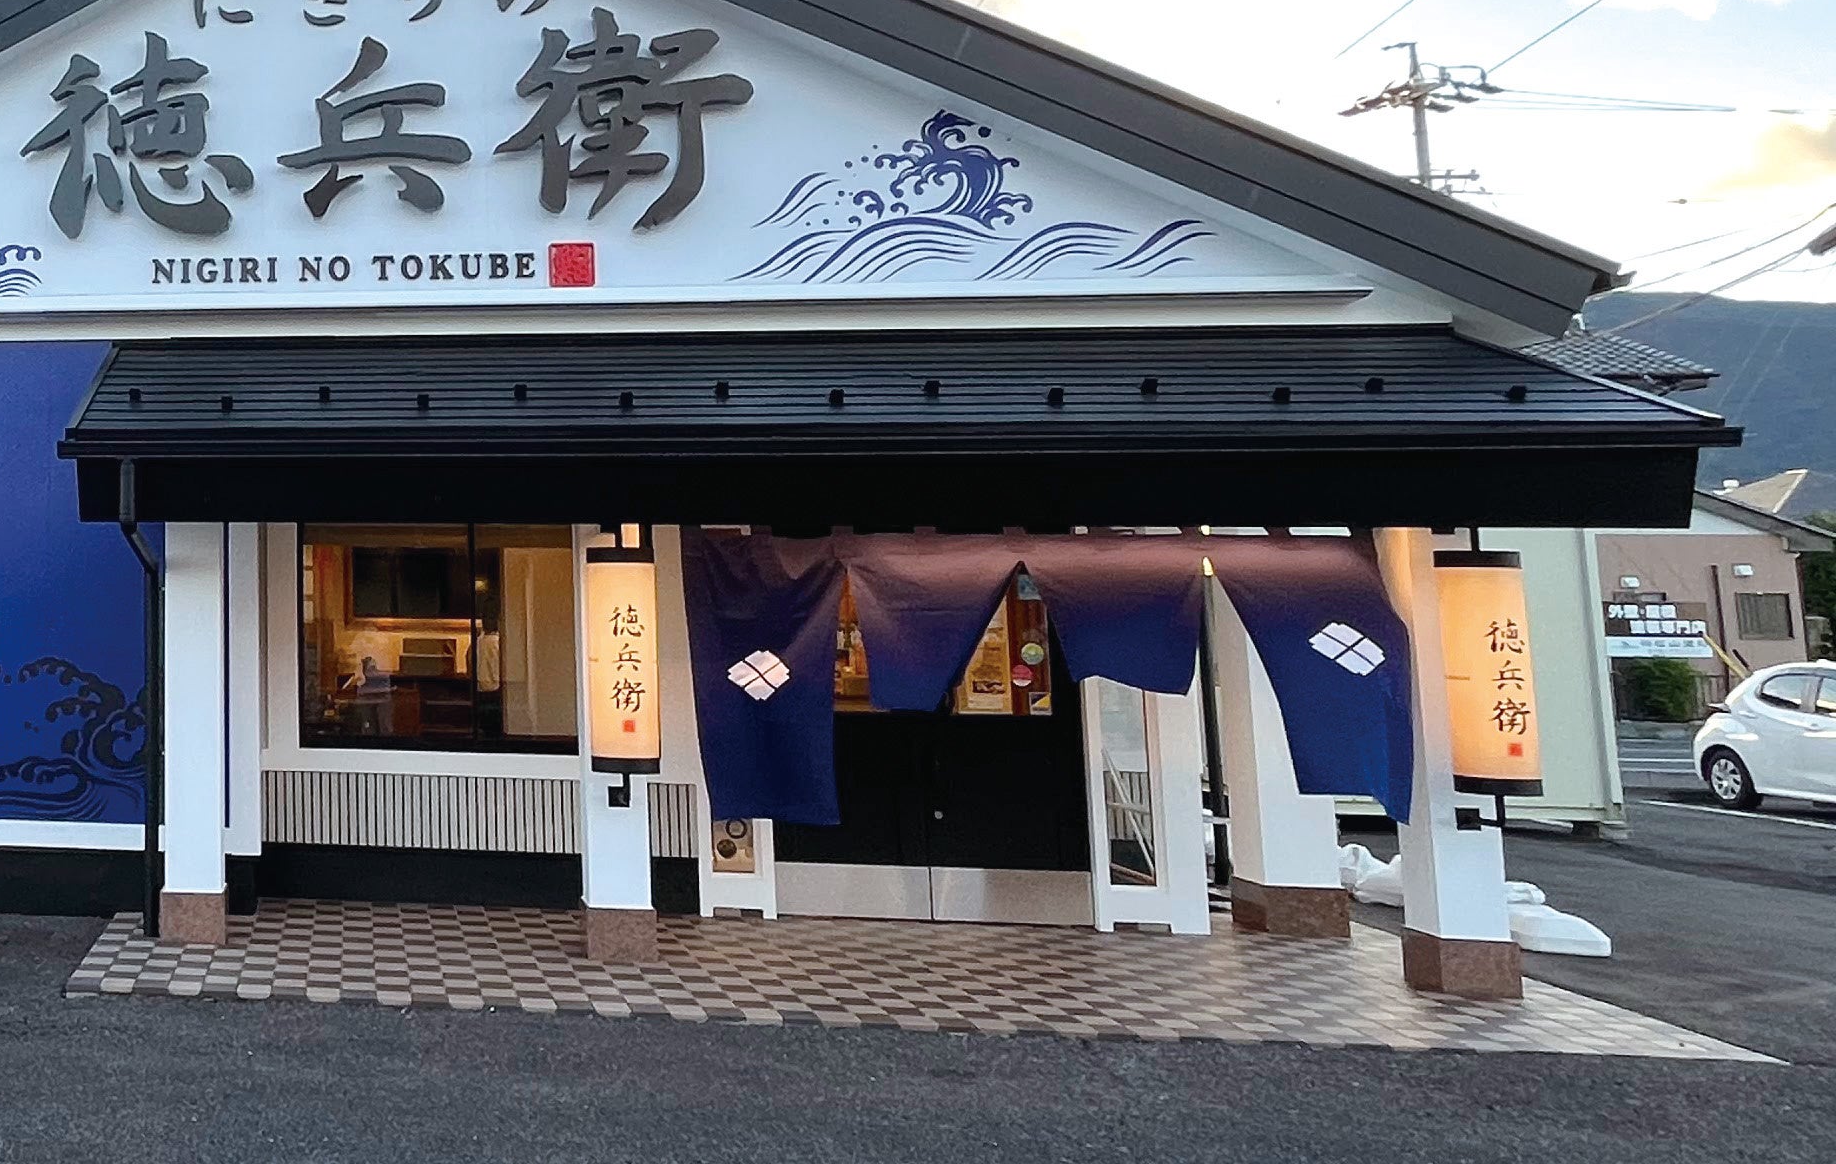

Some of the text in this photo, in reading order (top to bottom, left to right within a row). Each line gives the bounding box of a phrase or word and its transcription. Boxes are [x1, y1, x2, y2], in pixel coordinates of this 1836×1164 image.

[20, 7, 754, 238] 徳兵衛
[151, 256, 278, 284] NIGIRI
[298, 255, 351, 282] NO
[372, 253, 537, 281] TOKUBE
[608, 604, 646, 713] 徳兵衛
[1484, 619, 1531, 735] 徳兵衛
